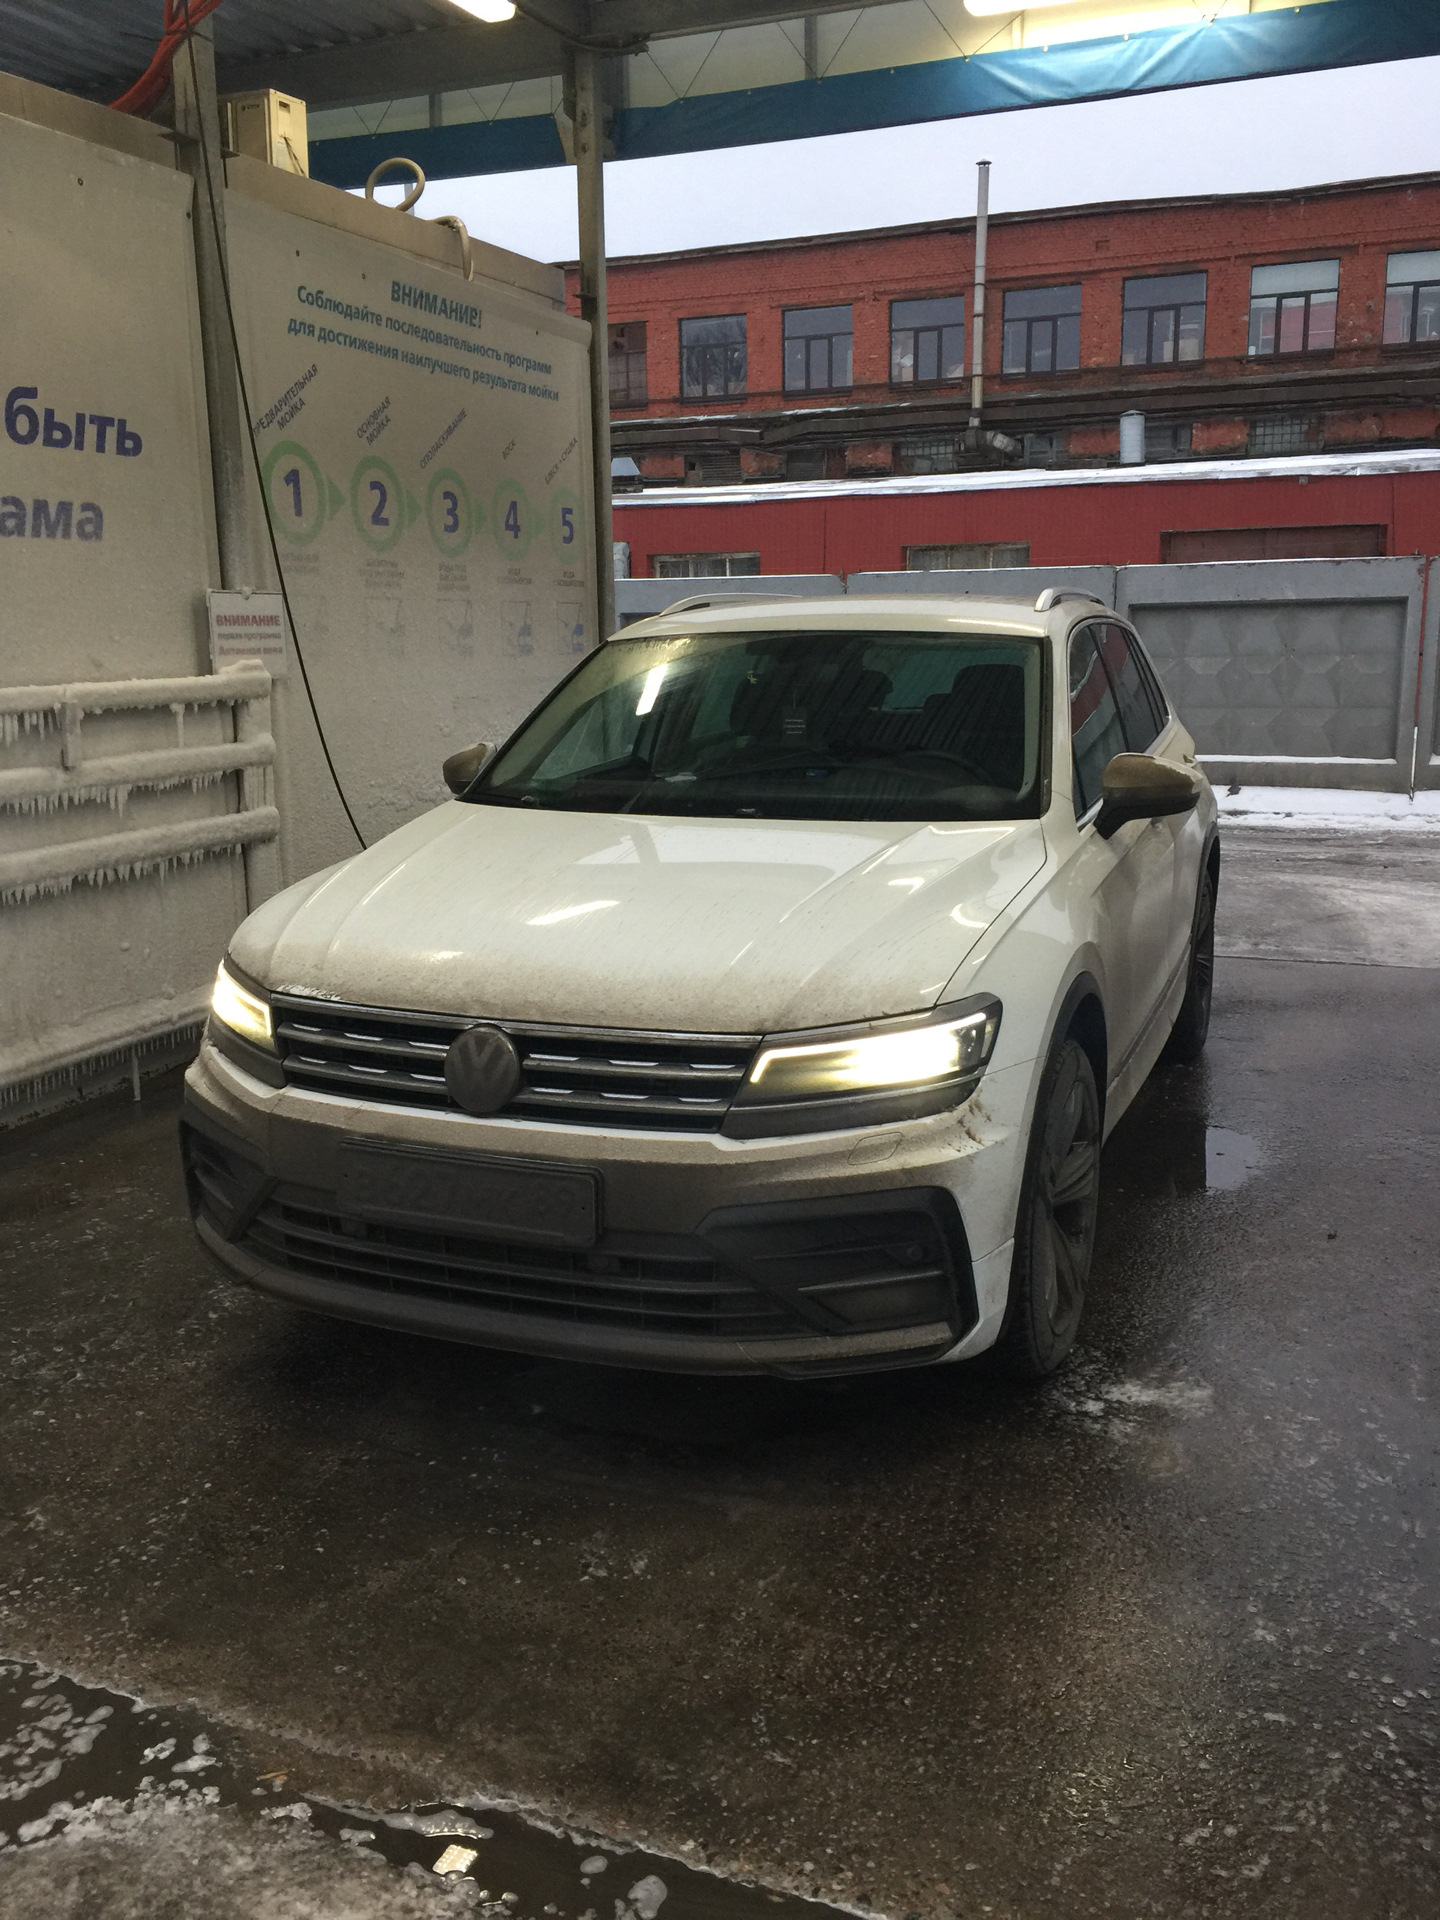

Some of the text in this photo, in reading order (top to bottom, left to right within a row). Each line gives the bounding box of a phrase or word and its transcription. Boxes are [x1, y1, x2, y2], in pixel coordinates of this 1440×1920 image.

[391, 280, 482, 329] ВНИМАНИЕ!
[297, 285, 552, 375] Соблюдайте последовательность программ
[288, 317, 559, 401] для достижения наилучшего результата мойки
[5, 386, 143, 457] быть
[276, 397, 306, 431] МОЙКА
[357, 396, 391, 439] ОСНОВНАЯ
[365, 415, 391, 446] МОЙКА
[419, 408, 467, 469] ОПОЛАСКИВАНИЕ
[283, 469, 302, 517] 1
[369, 481, 389, 526] 2
[442, 491, 459, 533] 3
[504, 500, 521, 539] 4
[561, 507, 574, 544] 5
[216, 614, 281, 627] ВНИМАНИЕ
